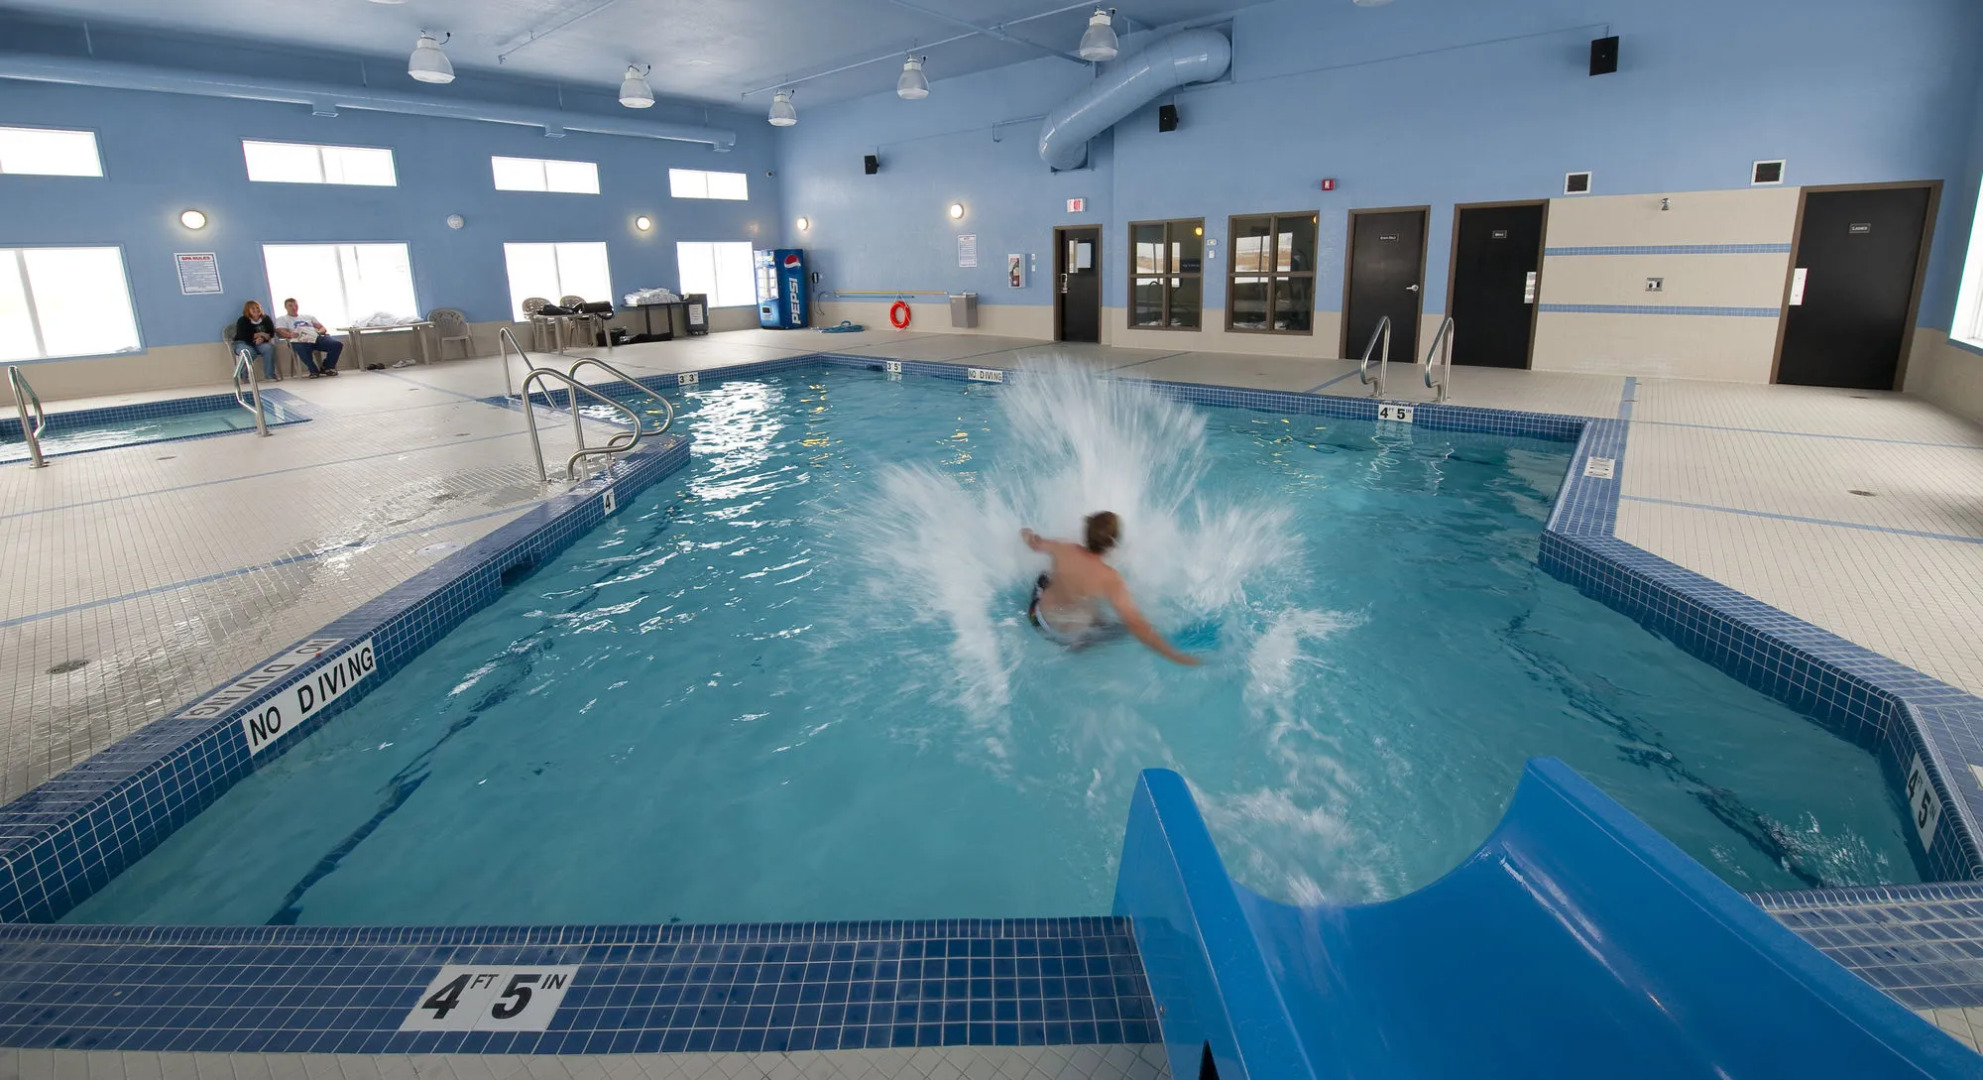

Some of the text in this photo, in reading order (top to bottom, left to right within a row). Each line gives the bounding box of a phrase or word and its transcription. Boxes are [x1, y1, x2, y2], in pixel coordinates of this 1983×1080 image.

[789, 277, 801, 324] PEPSI
[679, 373, 695, 384] 3 3
[1380, 407, 1389, 418] 4
[1397, 408, 1406, 420] 5
[605, 494, 611, 510] 4
[249, 646, 374, 746] NO DIVING
[1908, 769, 1919, 802] 4
[1918, 789, 1932, 829] 5
[421, 974, 473, 1020] 4
[491, 974, 542, 1020] 5
